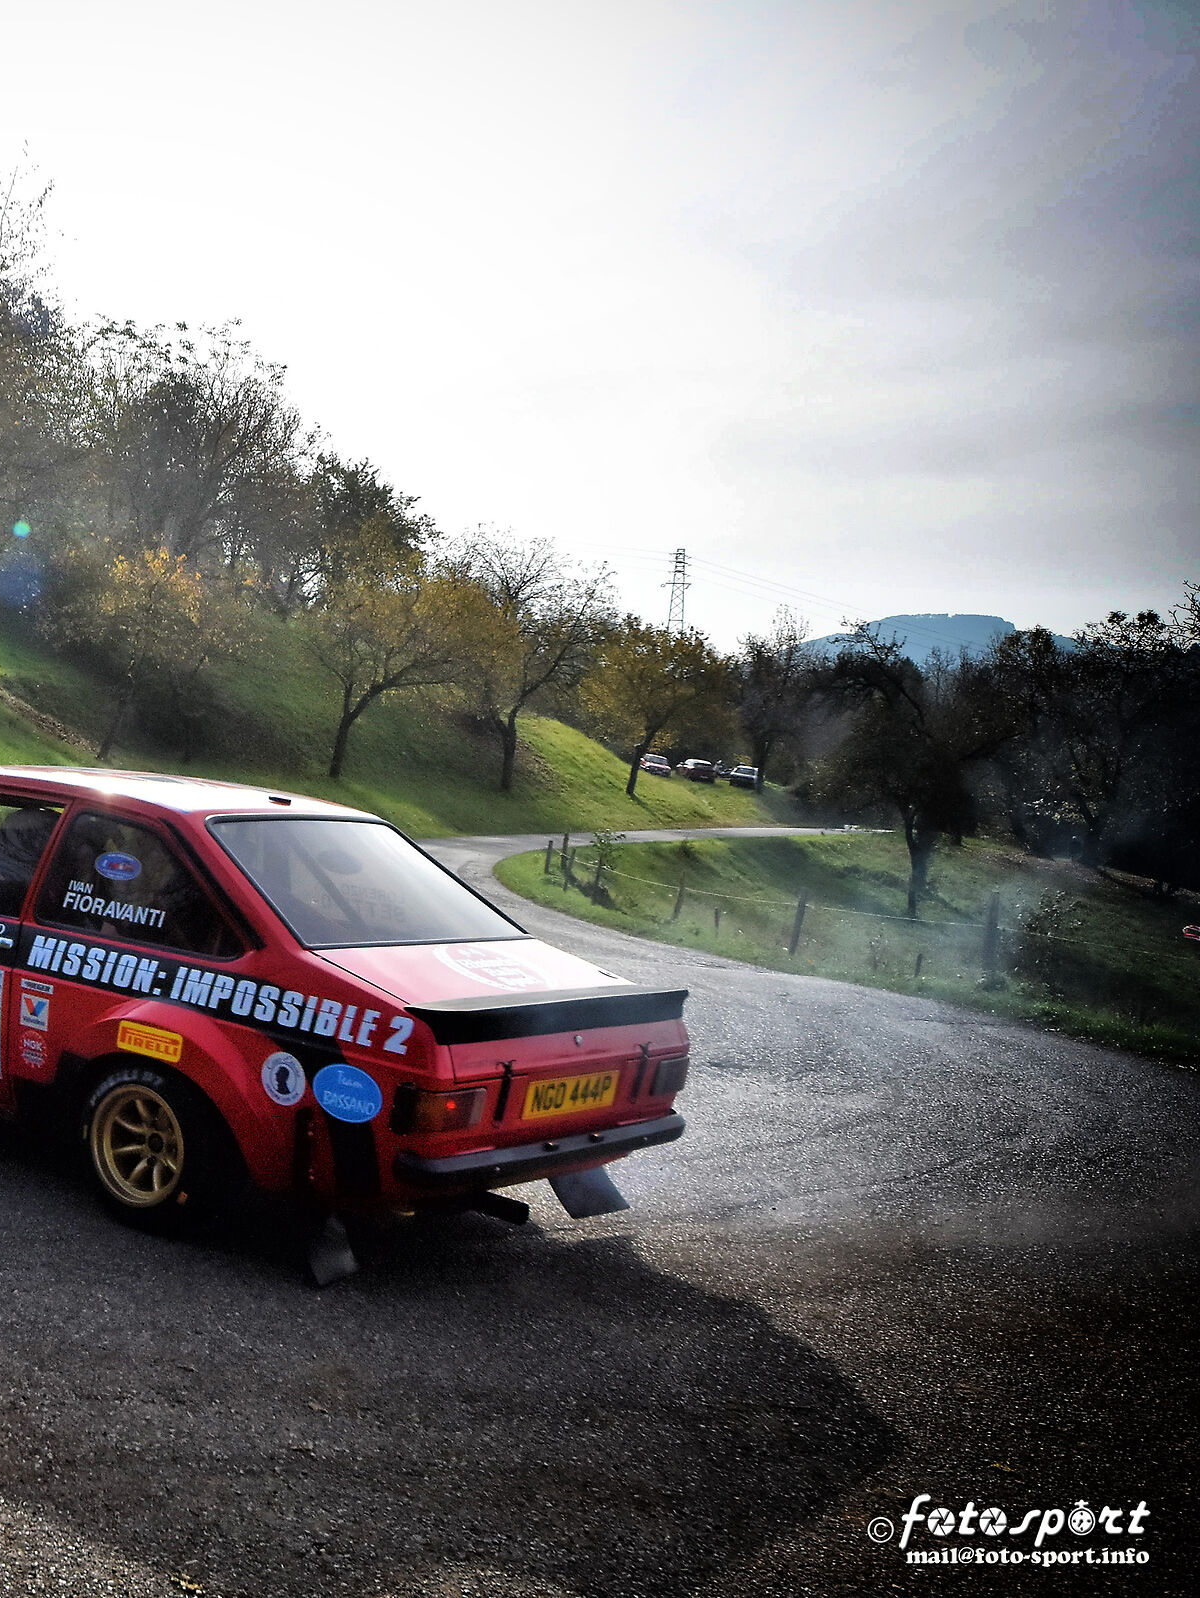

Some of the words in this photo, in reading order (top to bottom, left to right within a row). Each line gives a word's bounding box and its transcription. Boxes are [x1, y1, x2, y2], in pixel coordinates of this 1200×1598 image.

[68, 880, 94, 894] IVAN
[62, 891, 167, 928] FIORAVANTI
[26, 935, 167, 995] MISSION:
[170, 966, 382, 1048] IMPOSSIBLE
[383, 1015, 415, 1056] 2
[23, 1039, 43, 1051] NGK
[119, 1025, 180, 1057] PIRELLI
[323, 1090, 376, 1116] BASSANO
